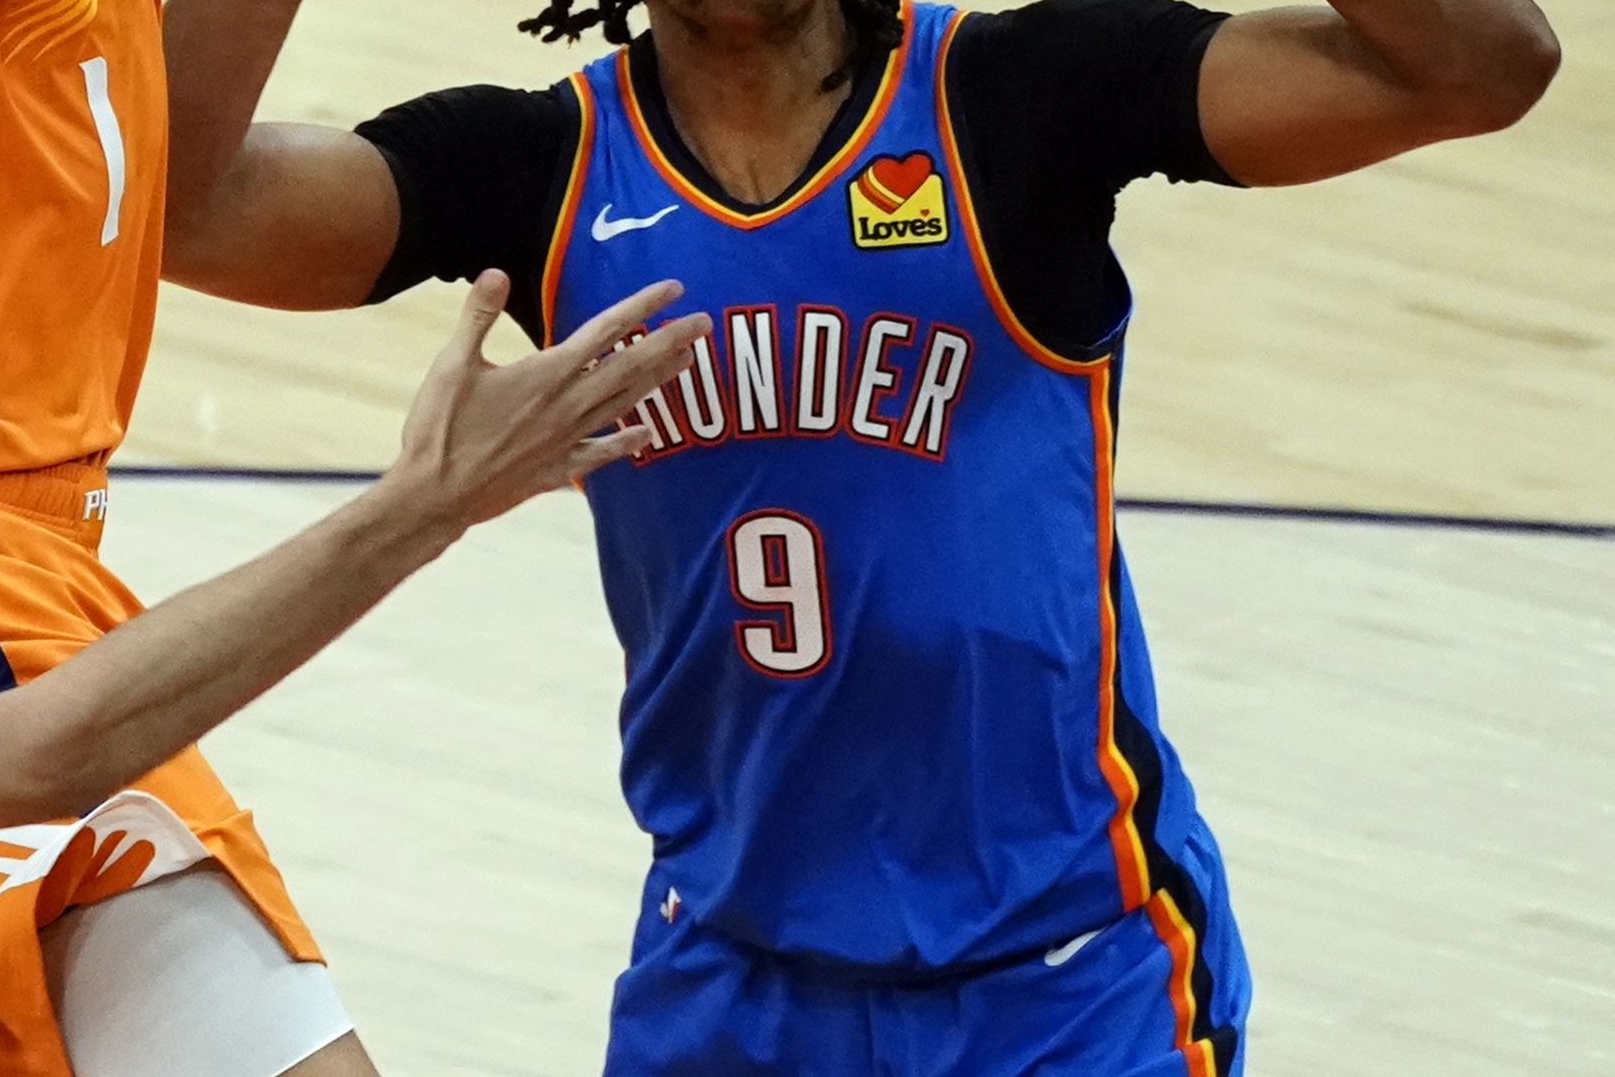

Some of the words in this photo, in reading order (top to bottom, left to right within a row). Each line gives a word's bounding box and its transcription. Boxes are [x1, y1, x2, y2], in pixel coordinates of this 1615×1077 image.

[78, 55, 125, 247] 1
[586, 303, 973, 465] HUNDER
[726, 508, 832, 678] 9
